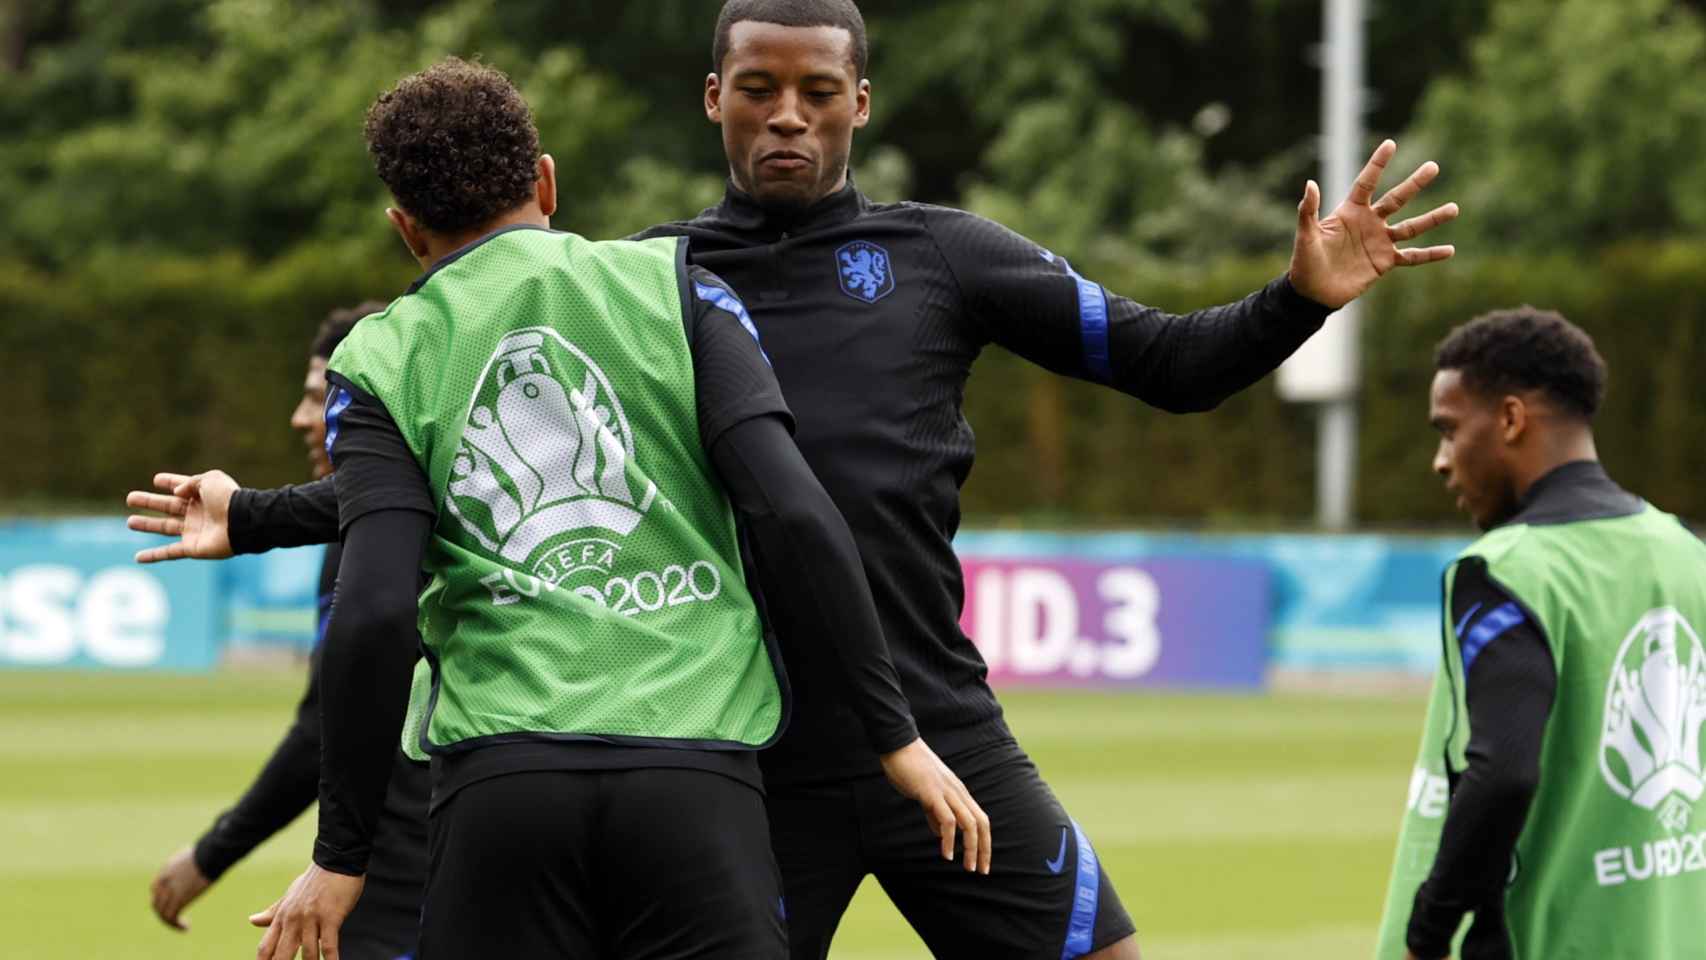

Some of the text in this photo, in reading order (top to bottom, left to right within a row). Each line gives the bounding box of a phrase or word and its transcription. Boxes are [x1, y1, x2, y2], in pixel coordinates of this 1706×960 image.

[479, 560, 720, 616] EU2020
[537, 544, 612, 581] UEFA
[975, 565, 1163, 679] ID.3
